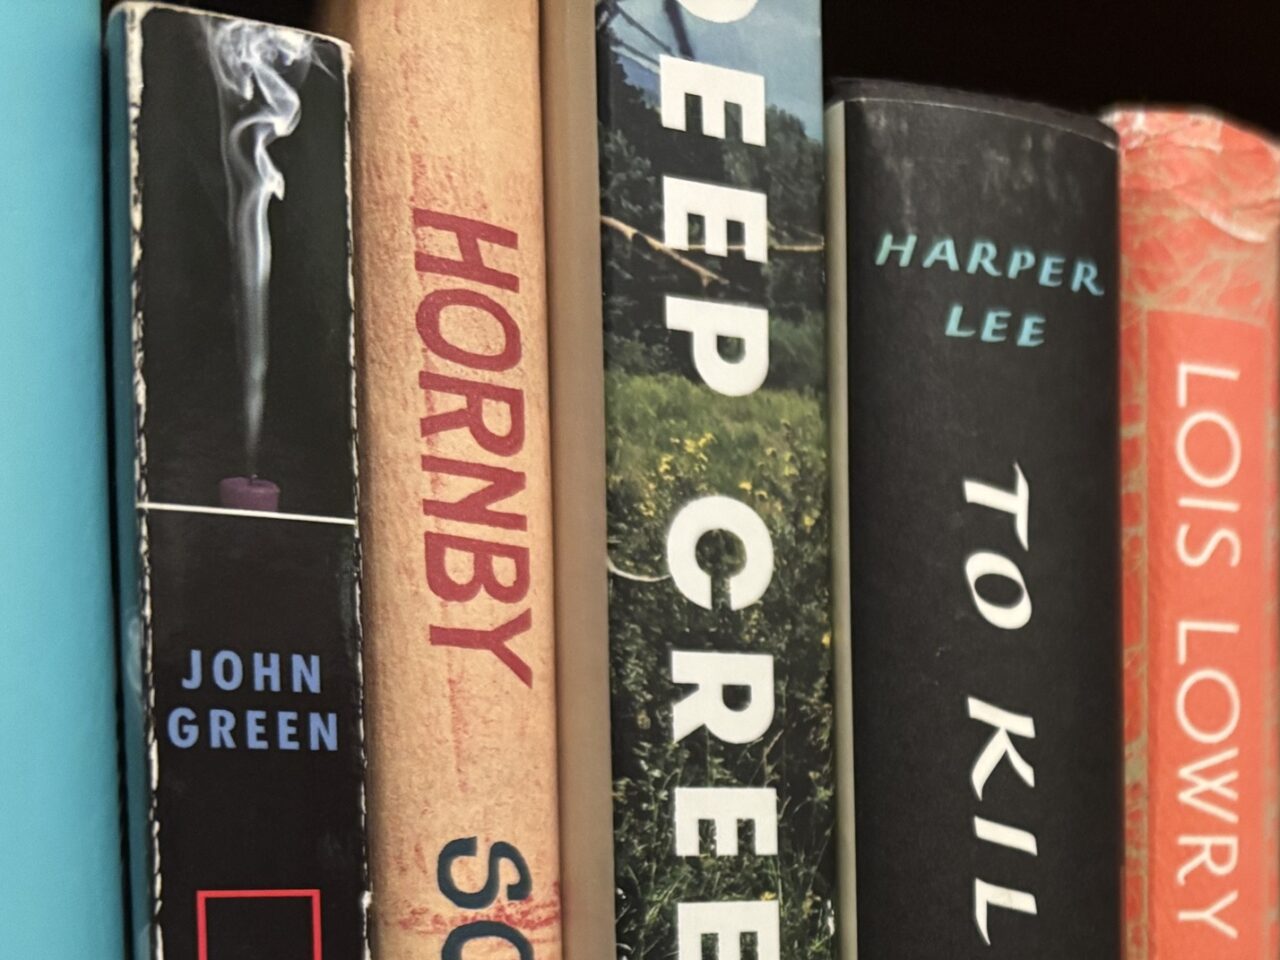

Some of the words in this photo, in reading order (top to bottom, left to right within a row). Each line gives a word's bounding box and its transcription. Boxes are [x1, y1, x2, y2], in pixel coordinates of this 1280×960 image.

[659, 0, 769, 397] EEP
[875, 233, 1105, 296] HARPER
[945, 305, 1047, 347] LEE
[412, 208, 534, 689] HORNBY
[1175, 361, 1243, 569] LOIS
[963, 462, 1033, 630] TO
[167, 707, 339, 752] GREEN
[181, 648, 322, 695] JOHN
[1175, 619, 1242, 940] LOWRY
